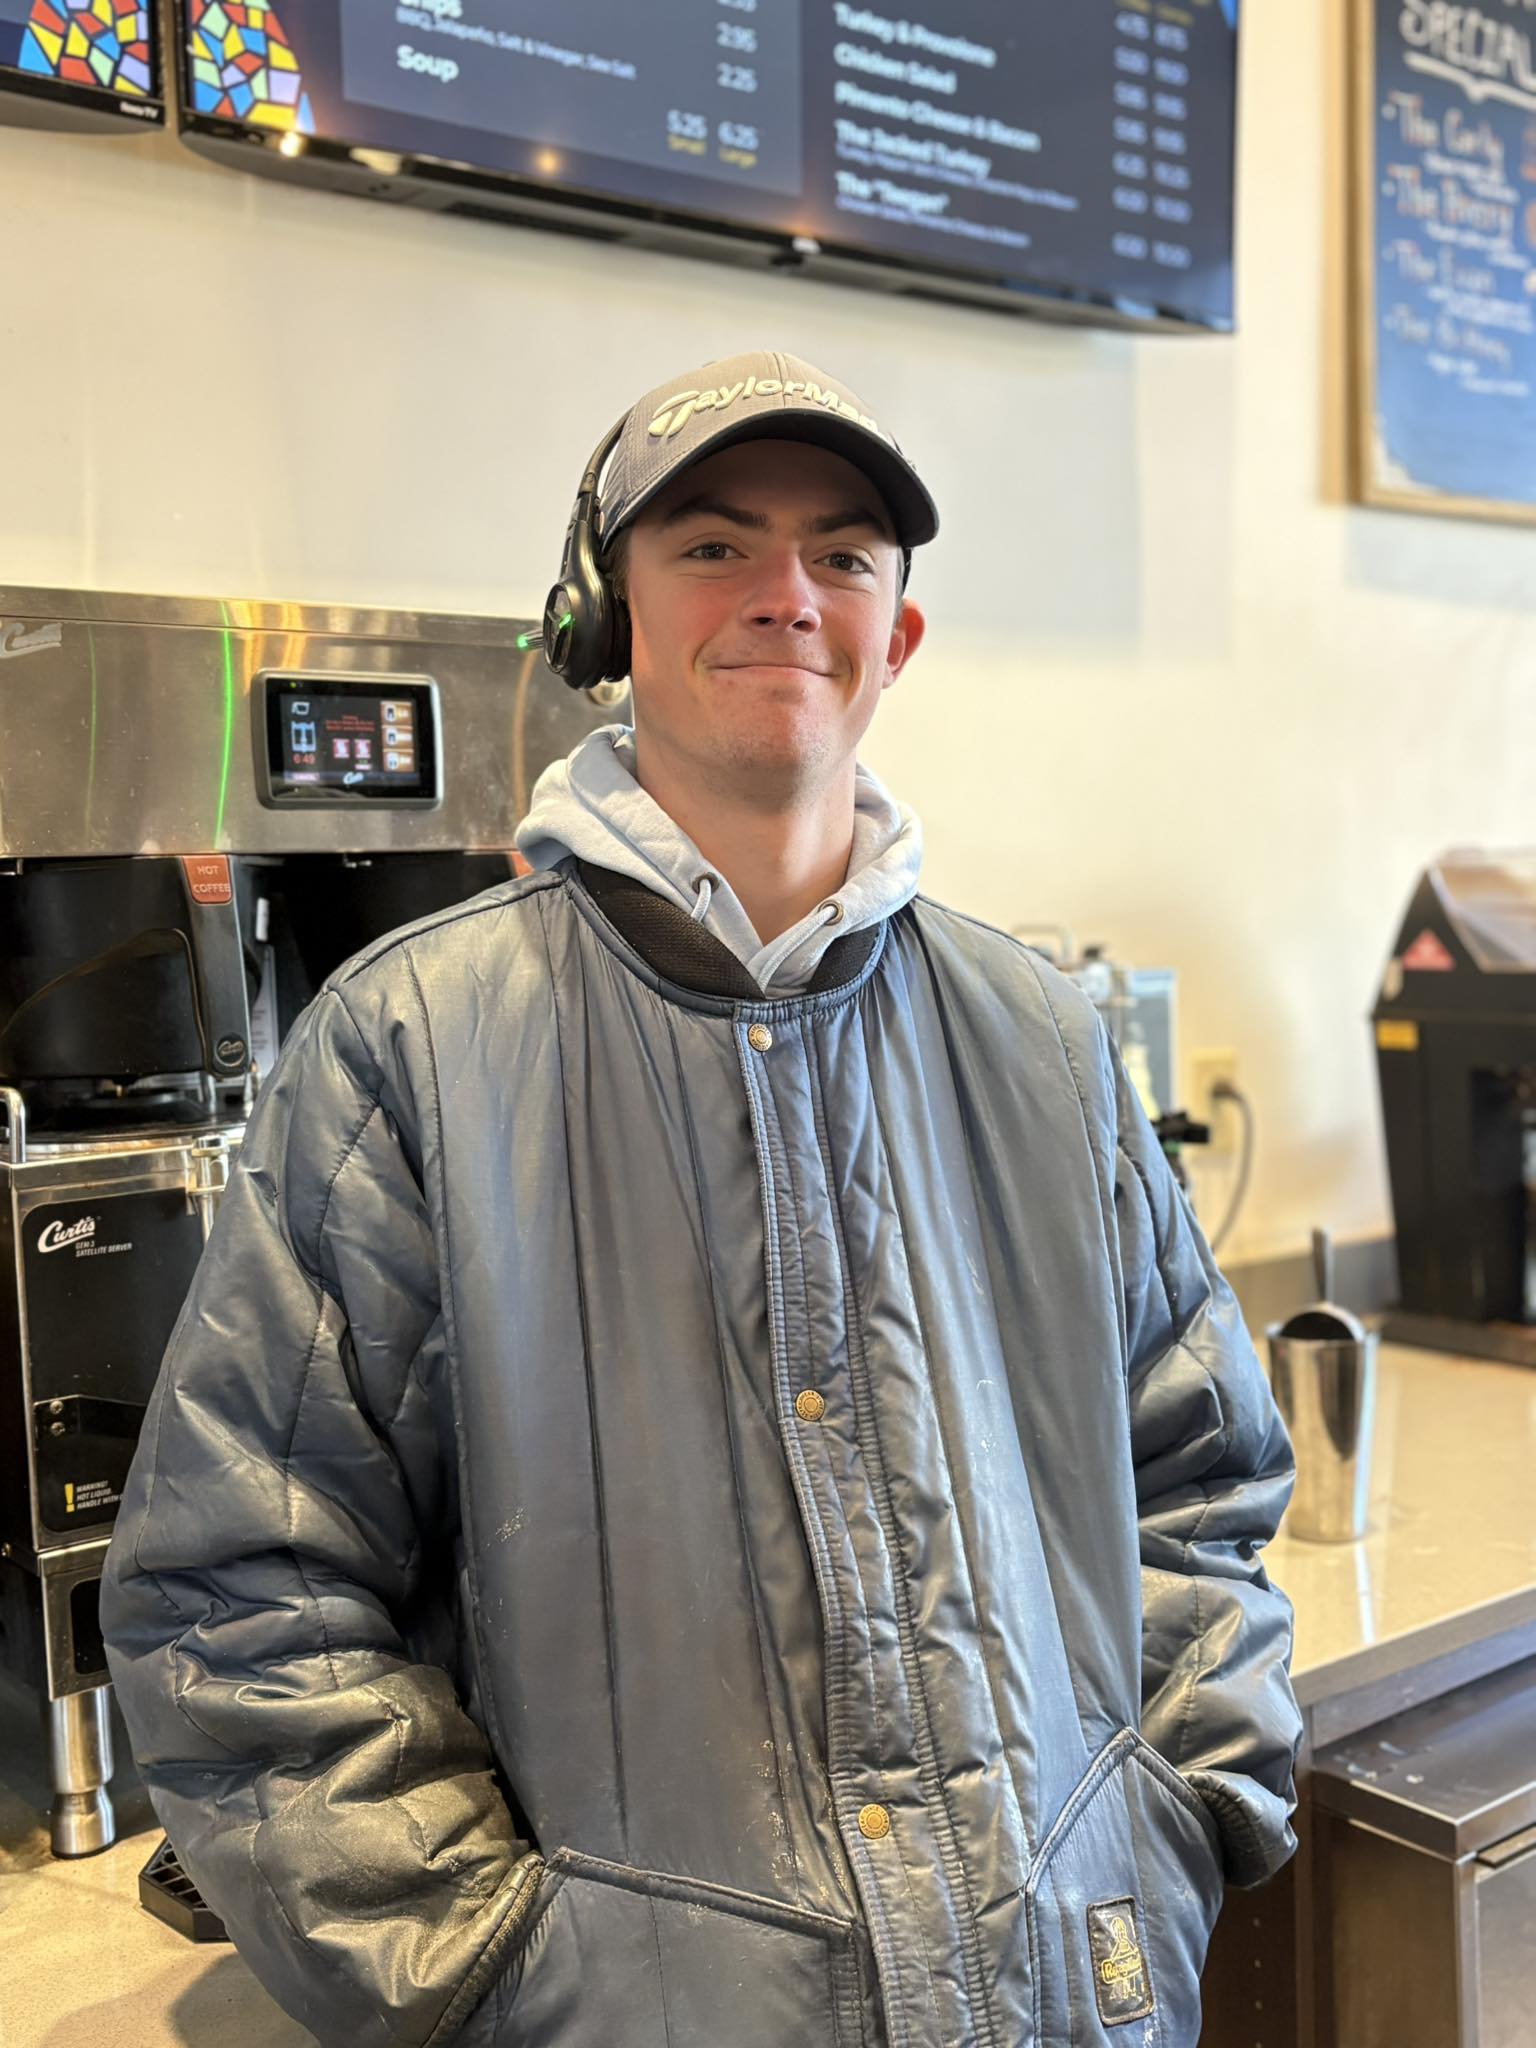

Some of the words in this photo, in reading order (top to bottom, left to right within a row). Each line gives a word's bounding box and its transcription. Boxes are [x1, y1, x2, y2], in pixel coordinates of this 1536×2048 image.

[396, 44, 460, 83] Soup
[196, 864, 219, 876] HOT
[193, 883, 231, 894] COFFEE
[37, 1215, 96, 1254] Curtis
